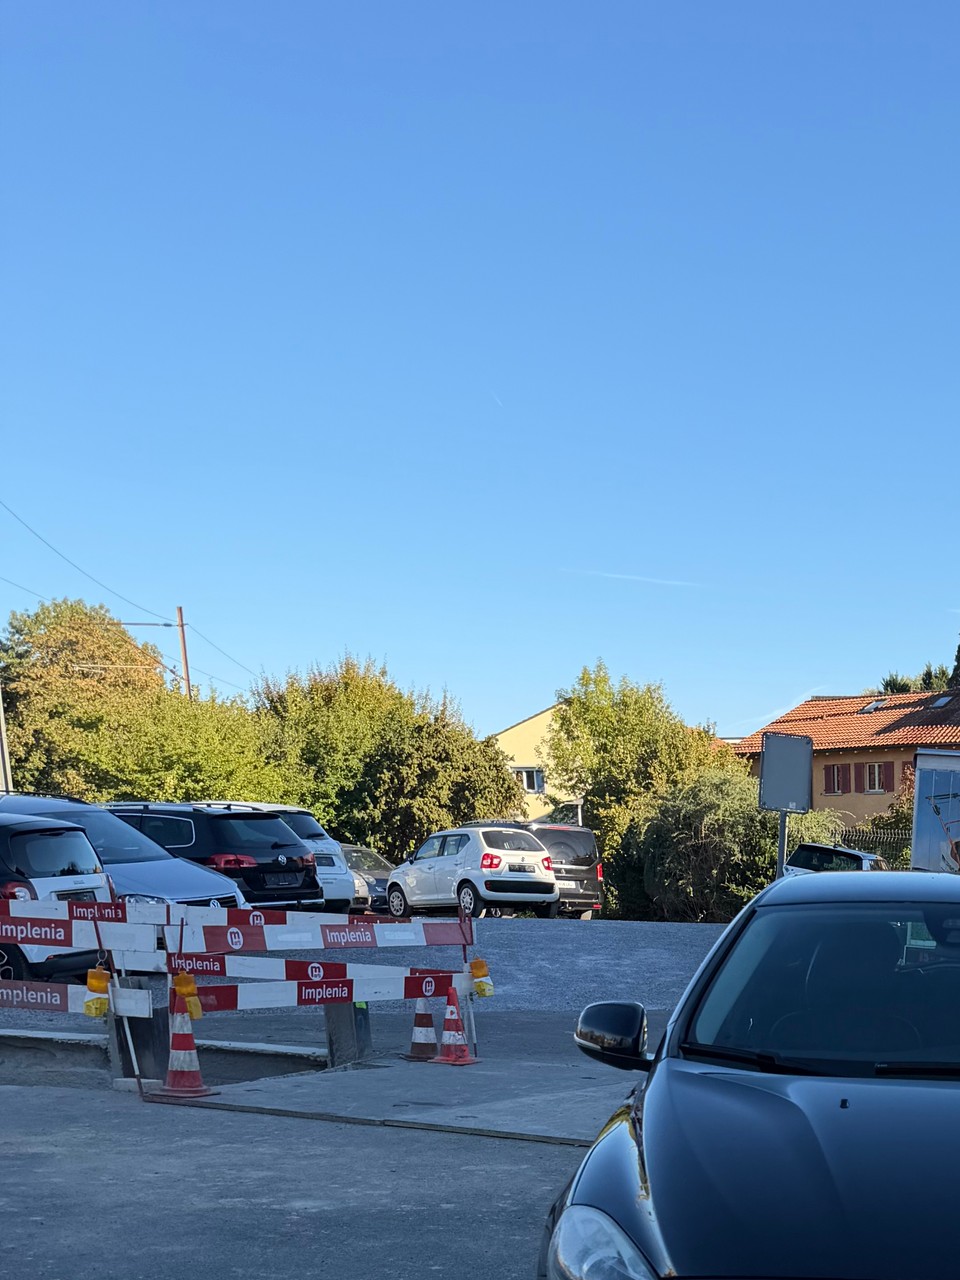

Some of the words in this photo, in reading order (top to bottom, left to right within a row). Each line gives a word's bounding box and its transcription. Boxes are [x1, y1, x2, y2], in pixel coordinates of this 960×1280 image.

[326, 928, 372, 945] Implenia
[171, 956, 221, 972] Implenia
[302, 984, 348, 1002] Implenia
